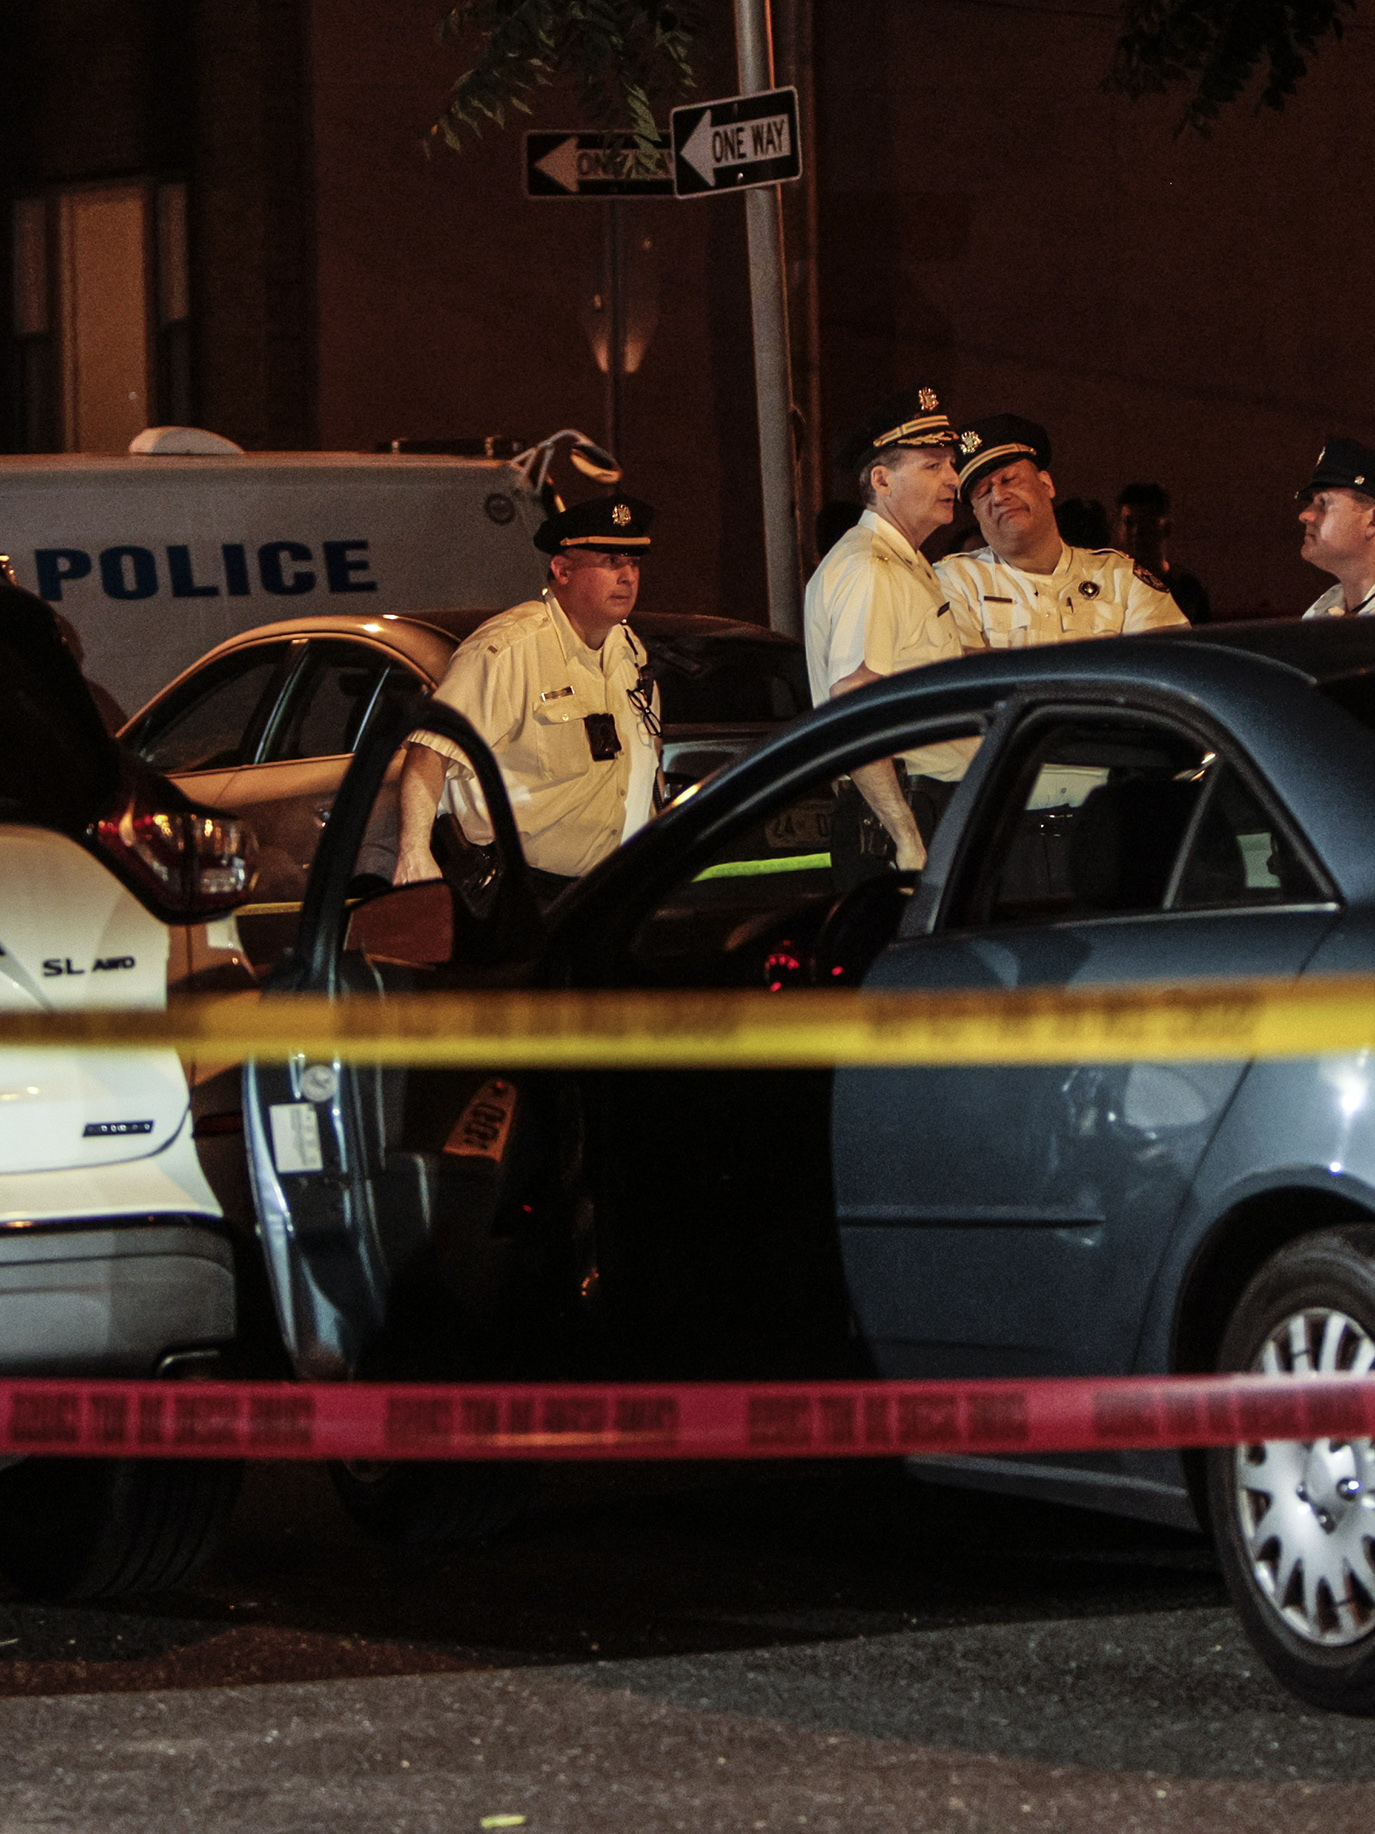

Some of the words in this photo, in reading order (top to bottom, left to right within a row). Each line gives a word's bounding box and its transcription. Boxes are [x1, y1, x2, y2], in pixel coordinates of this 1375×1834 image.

[712, 127, 747, 163] ONE
[751, 118, 786, 156] WAY
[34, 540, 378, 601] POLICE
[43, 958, 85, 977] SL
